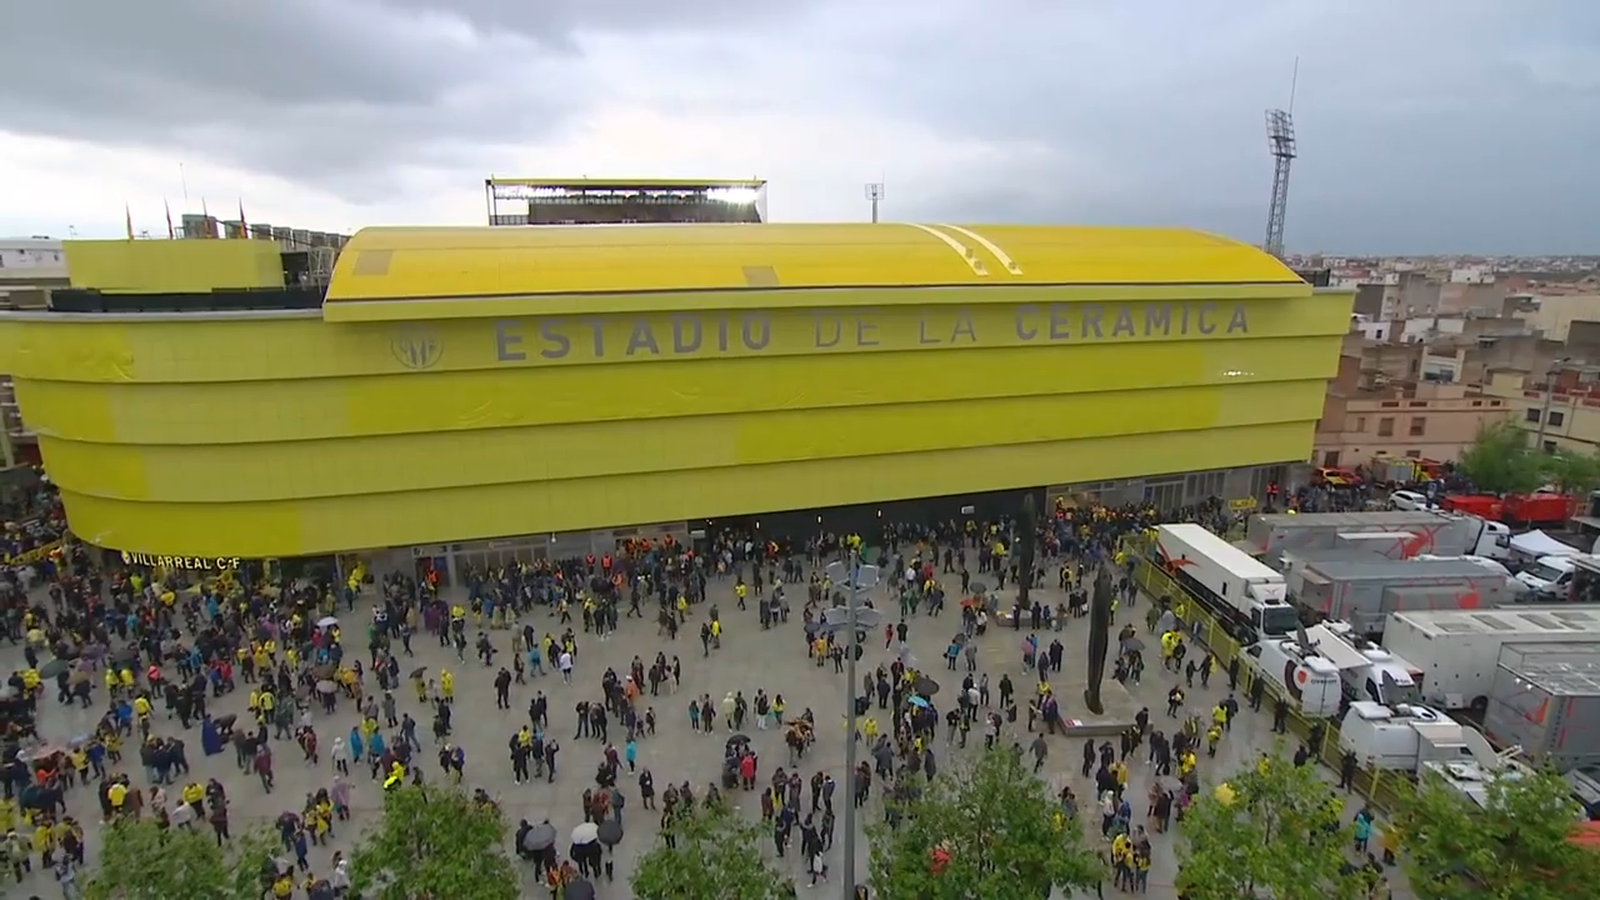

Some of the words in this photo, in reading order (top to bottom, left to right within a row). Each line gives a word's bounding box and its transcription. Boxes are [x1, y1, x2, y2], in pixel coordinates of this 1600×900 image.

[496, 309, 771, 362] ESTADIO
[814, 309, 879, 348] DE
[919, 307, 977, 344] LA
[1015, 303, 1250, 340] CERAMICA
[131, 553, 211, 569] VILLARREAL
